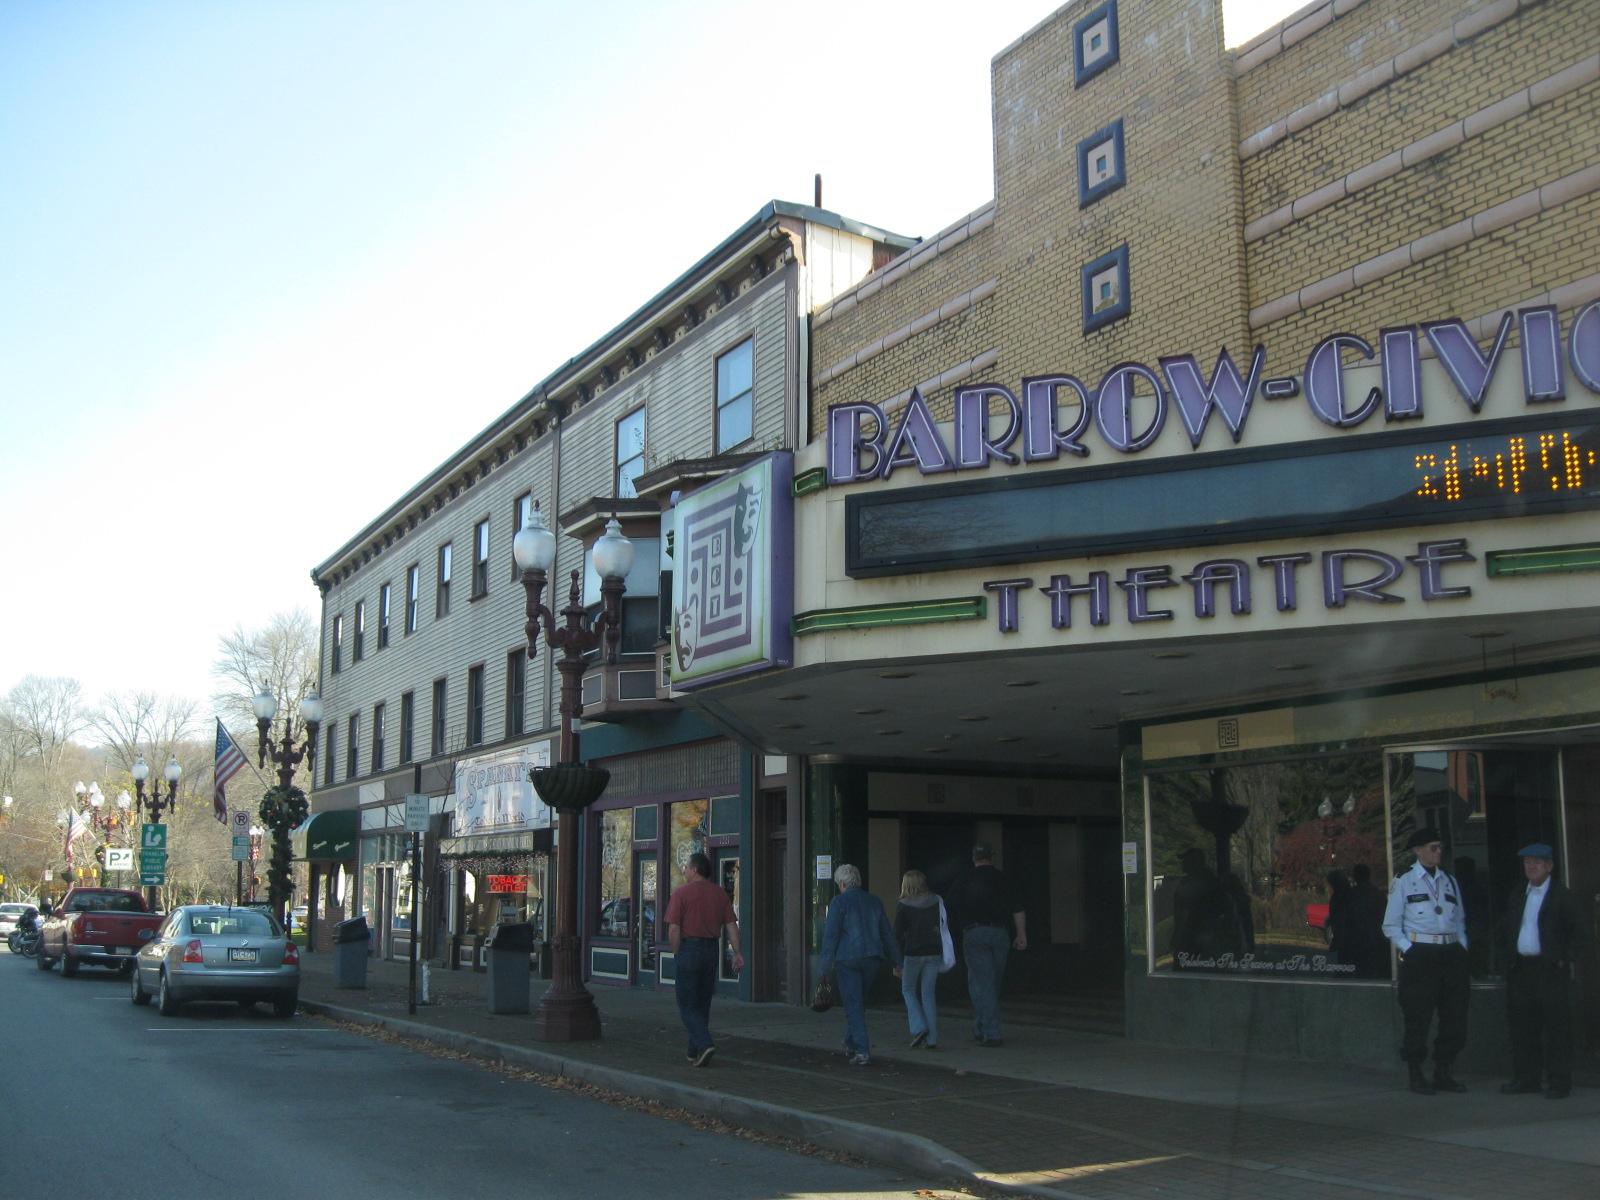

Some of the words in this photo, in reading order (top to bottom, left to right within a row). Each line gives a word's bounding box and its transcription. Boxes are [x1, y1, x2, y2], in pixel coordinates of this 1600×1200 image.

[983, 538, 1477, 633] THEATRE
[490, 882, 527, 892] OUTLET
[1177, 951, 1216, 970] Celebrate
[1216, 952, 1239, 969] The
[1275, 959, 1286, 971] at
[1286, 955, 1311, 971] The
[1312, 954, 1357, 973] Barrow
